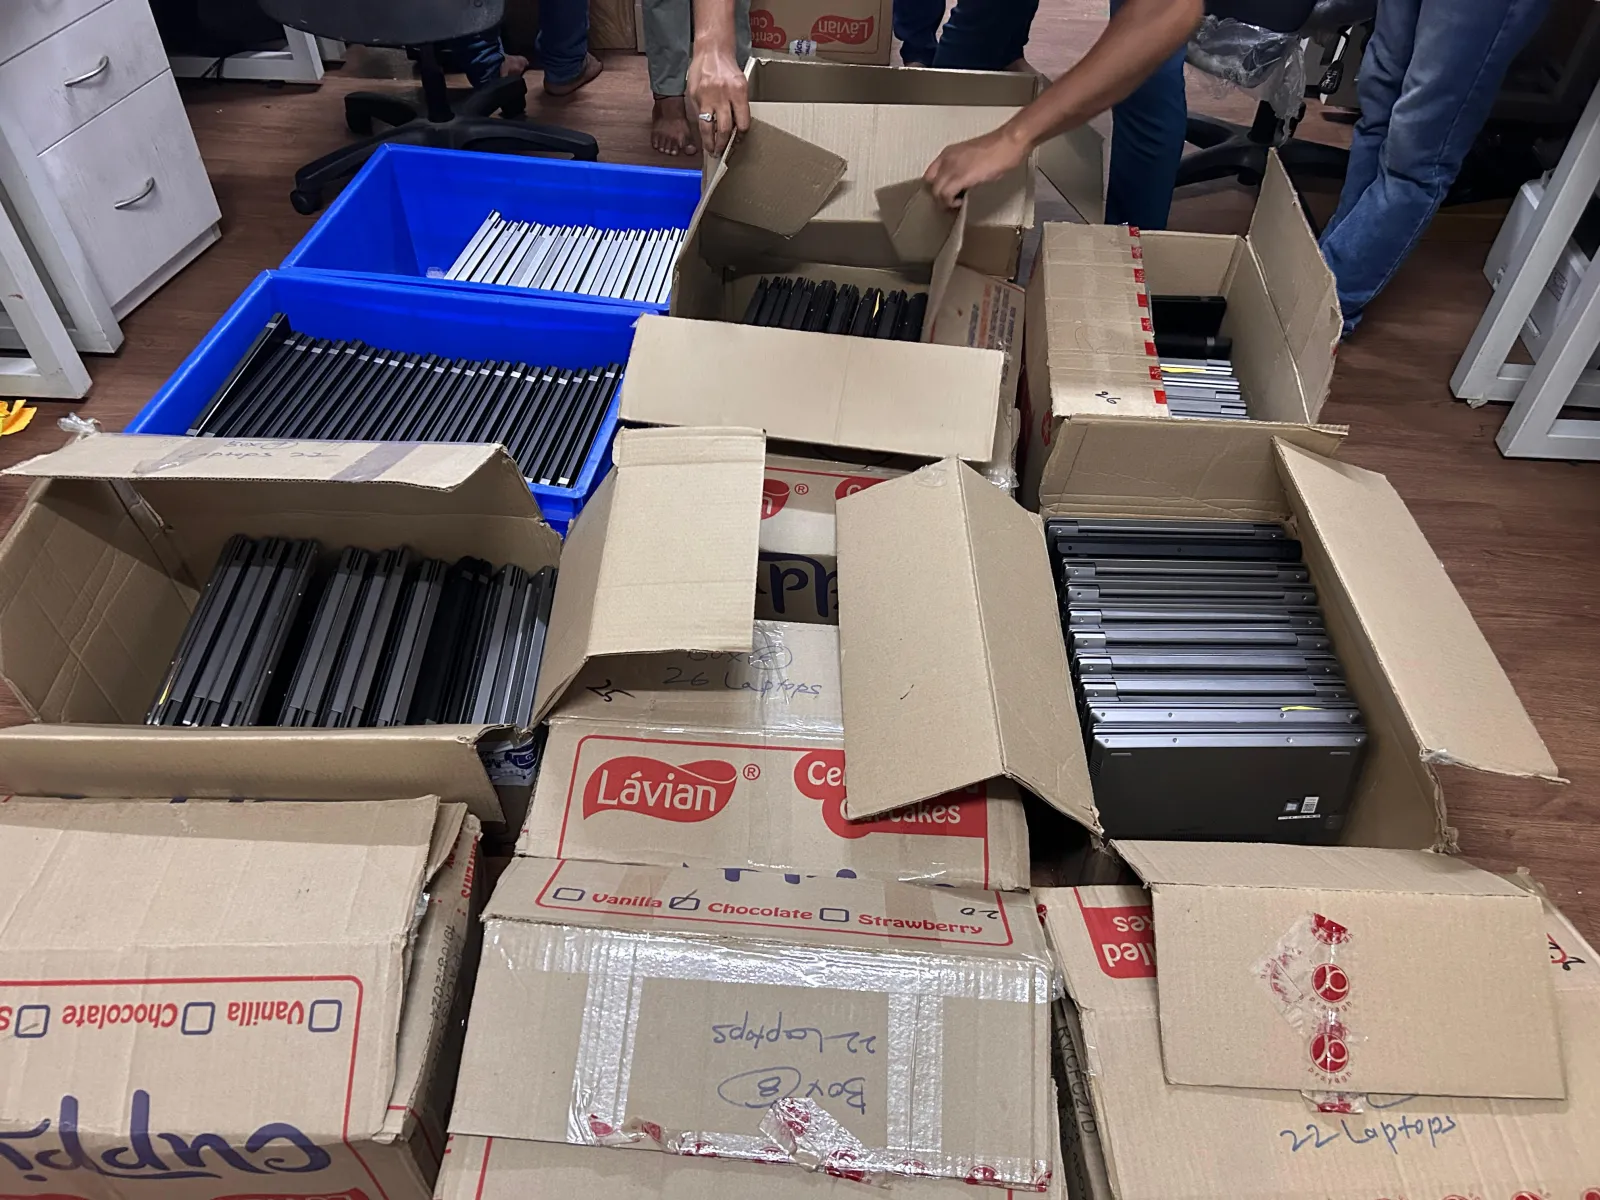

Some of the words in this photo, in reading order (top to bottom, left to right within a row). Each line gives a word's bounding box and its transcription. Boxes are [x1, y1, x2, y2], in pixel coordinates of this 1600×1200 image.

[662, 667, 709, 686] 26
[807, 760, 846, 786] Ce
[597, 768, 717, 812] Lávian
[592, 892, 662, 909] Vanilla
[707, 902, 813, 921] Chocolate
[857, 913, 984, 936] Strawberry
[62, 1002, 179, 1030] Chocolate
[227, 1000, 304, 1027] Vanilla
[806, 1076, 866, 1115] Box
[1280, 1123, 1340, 1151] 22
